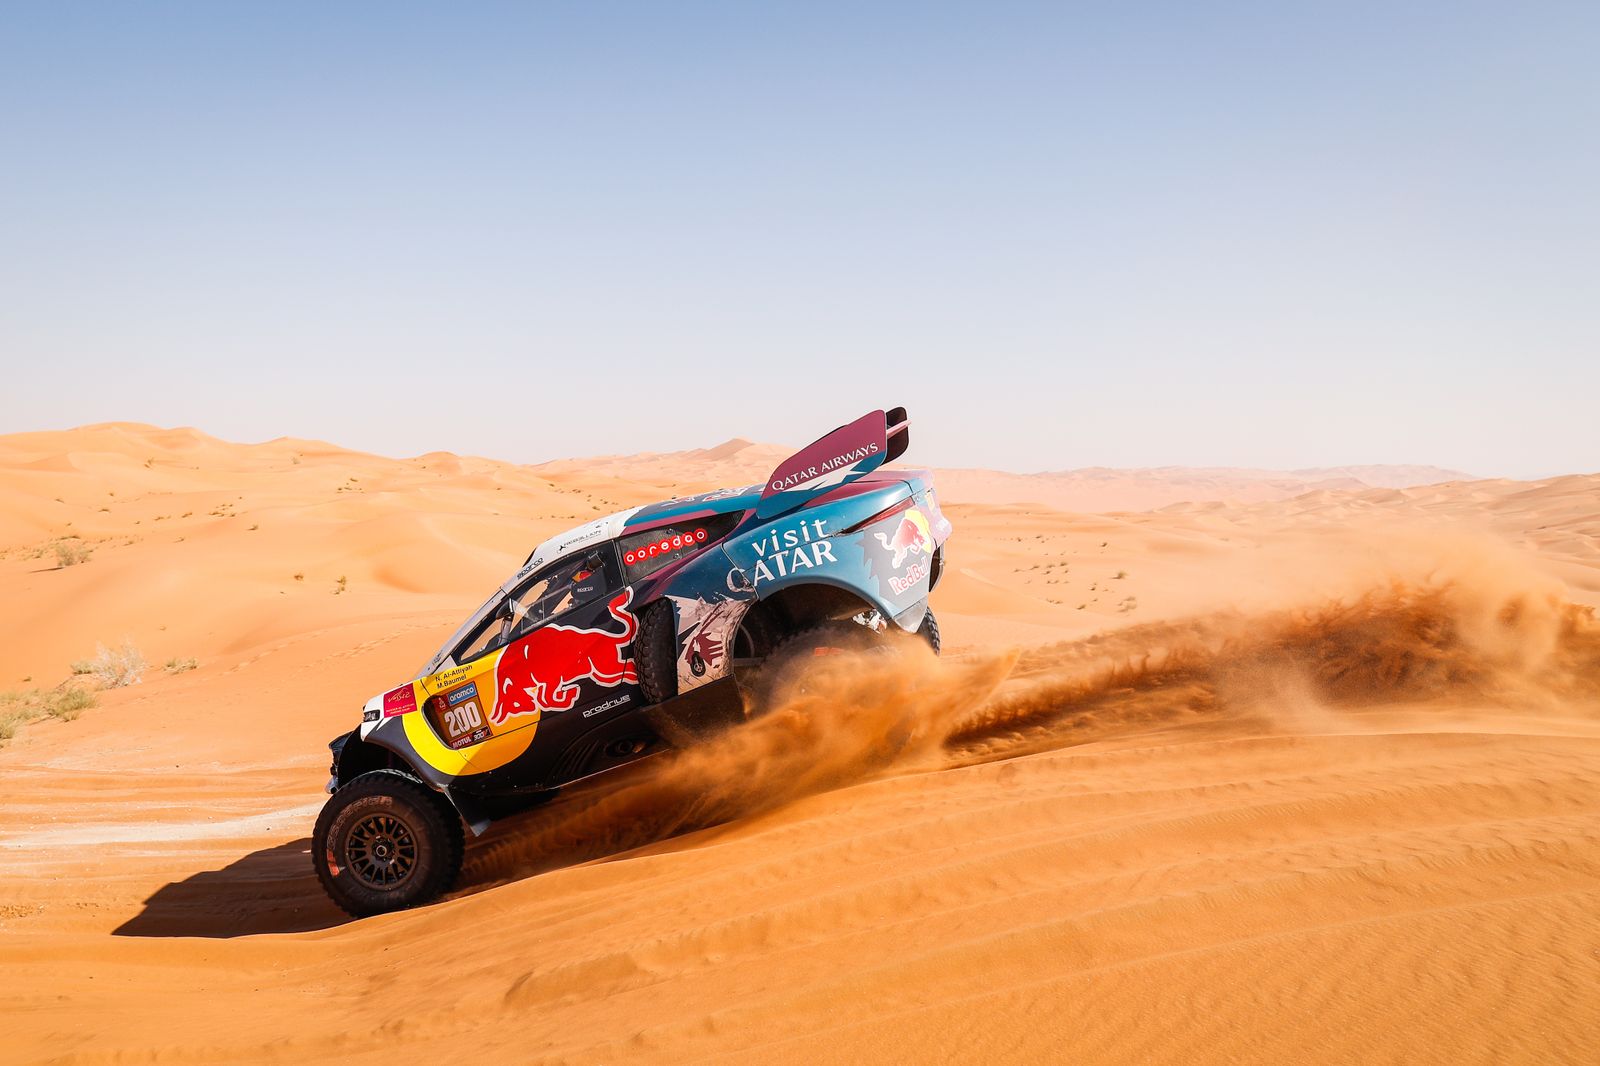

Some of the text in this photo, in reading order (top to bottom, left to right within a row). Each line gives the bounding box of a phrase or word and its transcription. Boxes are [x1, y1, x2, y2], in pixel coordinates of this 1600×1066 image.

[772, 443, 879, 491] QATAR AIRWAYS
[626, 531, 704, 562] ooredoo
[752, 519, 828, 557] visit
[517, 558, 544, 580] sparco
[726, 540, 837, 593] QATAR
[888, 556, 929, 595] Red Bull
[449, 686, 475, 702] aramco
[583, 694, 631, 719] prodrive
[444, 701, 482, 738] 200
[452, 736, 472, 749] MOTUL
